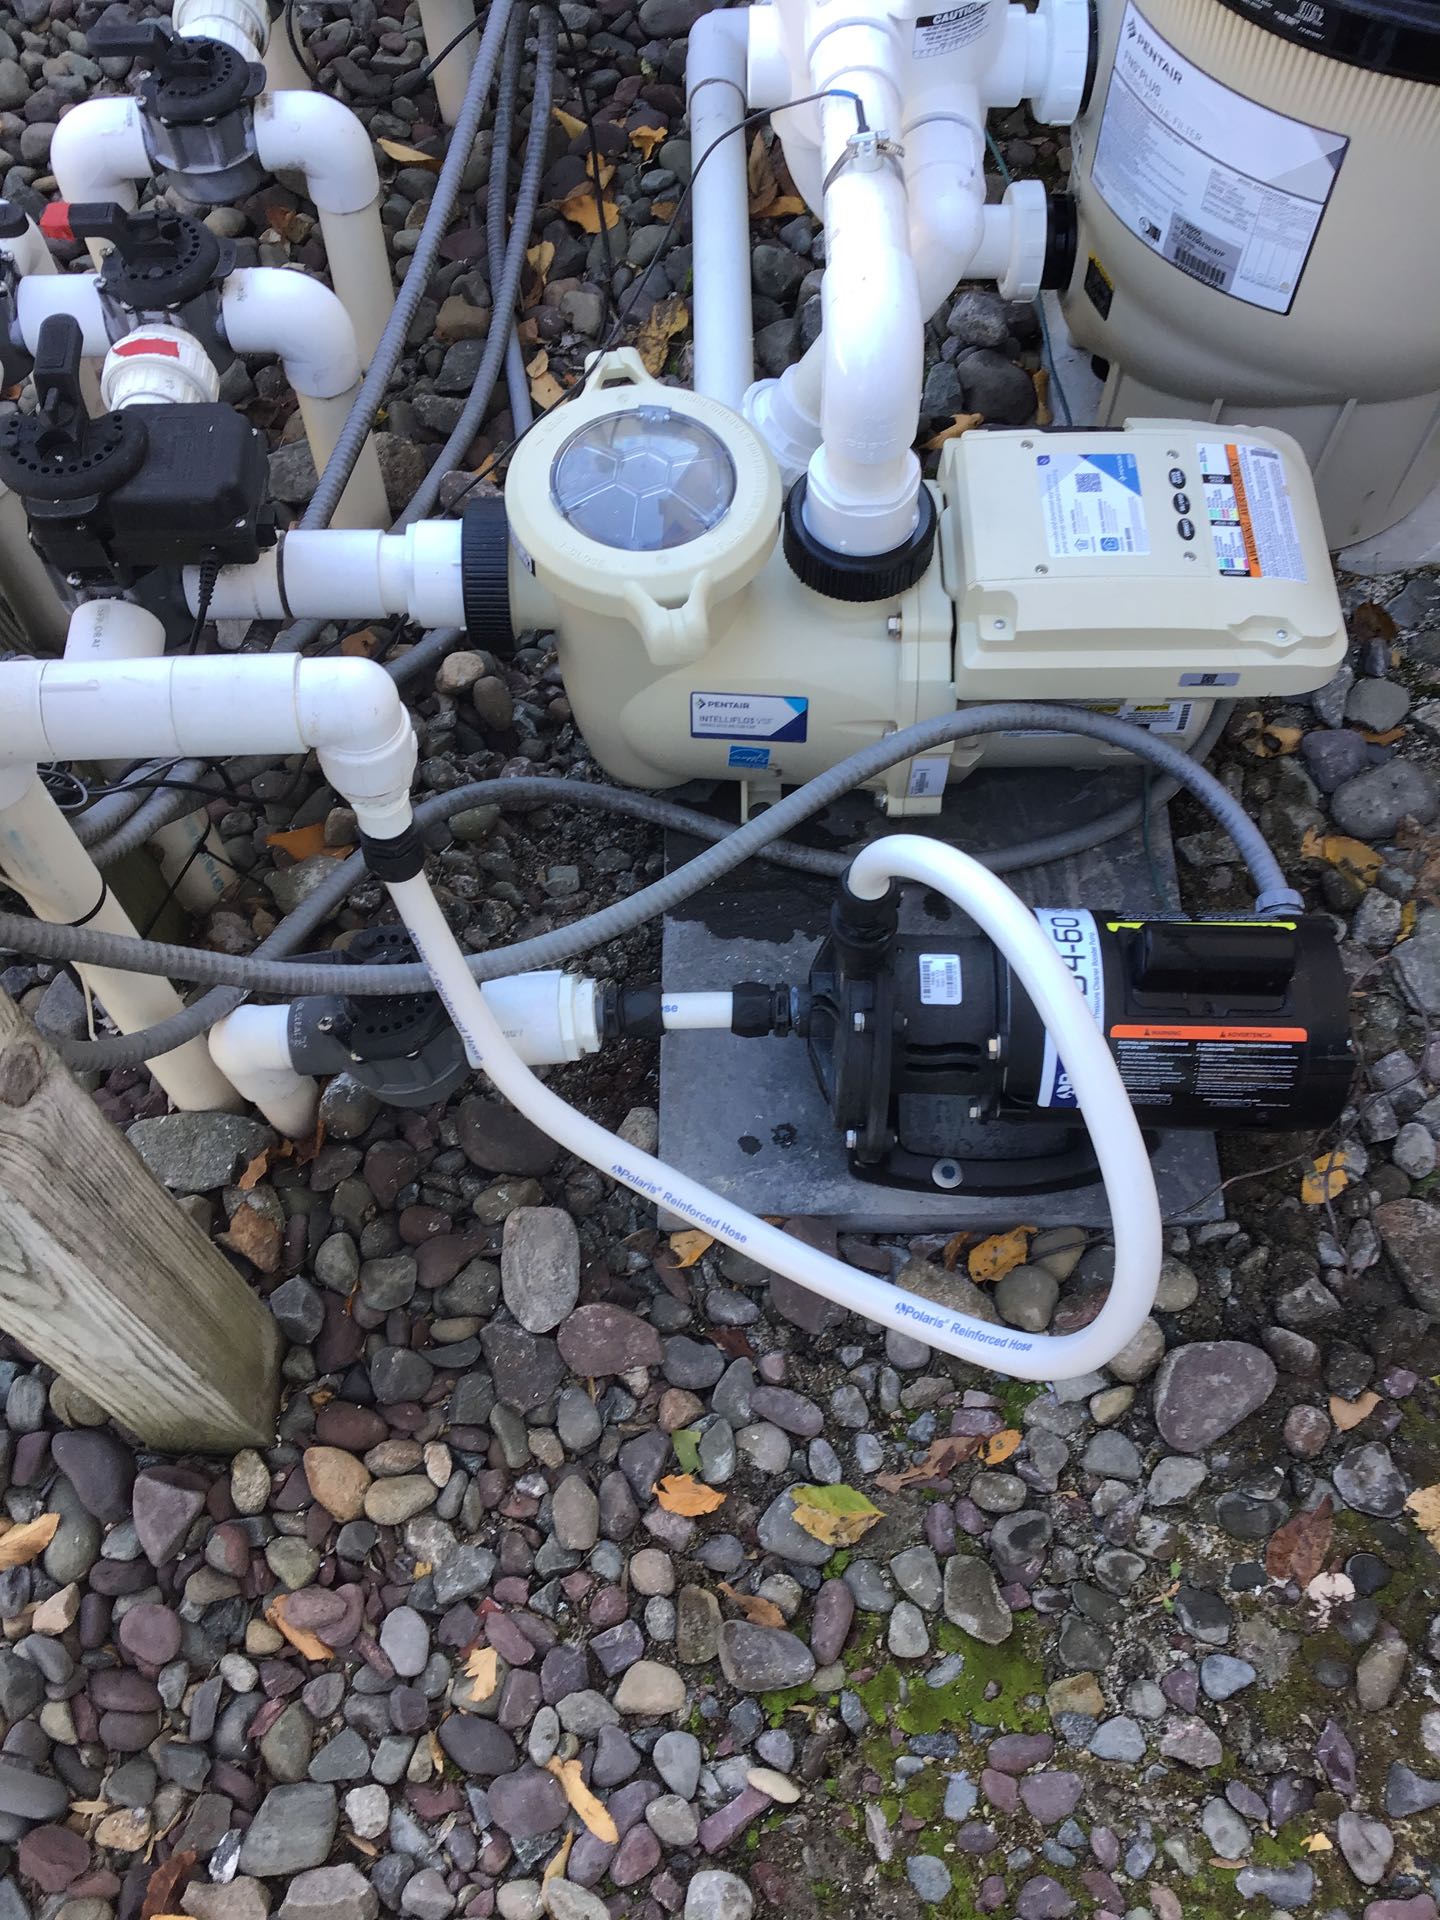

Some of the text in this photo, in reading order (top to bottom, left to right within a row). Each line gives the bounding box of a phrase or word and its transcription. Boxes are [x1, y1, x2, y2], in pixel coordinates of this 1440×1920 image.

[1136, 34, 1184, 85] PENTAIR
[708, 701, 750, 709] PENTAIR
[464, 1033, 484, 1062] Hose
[662, 1191, 720, 1229] Reinforced
[720, 1222, 748, 1244] Hose
[950, 1322, 1009, 1348] Reinforced
[1007, 1338, 1033, 1351] Hose
